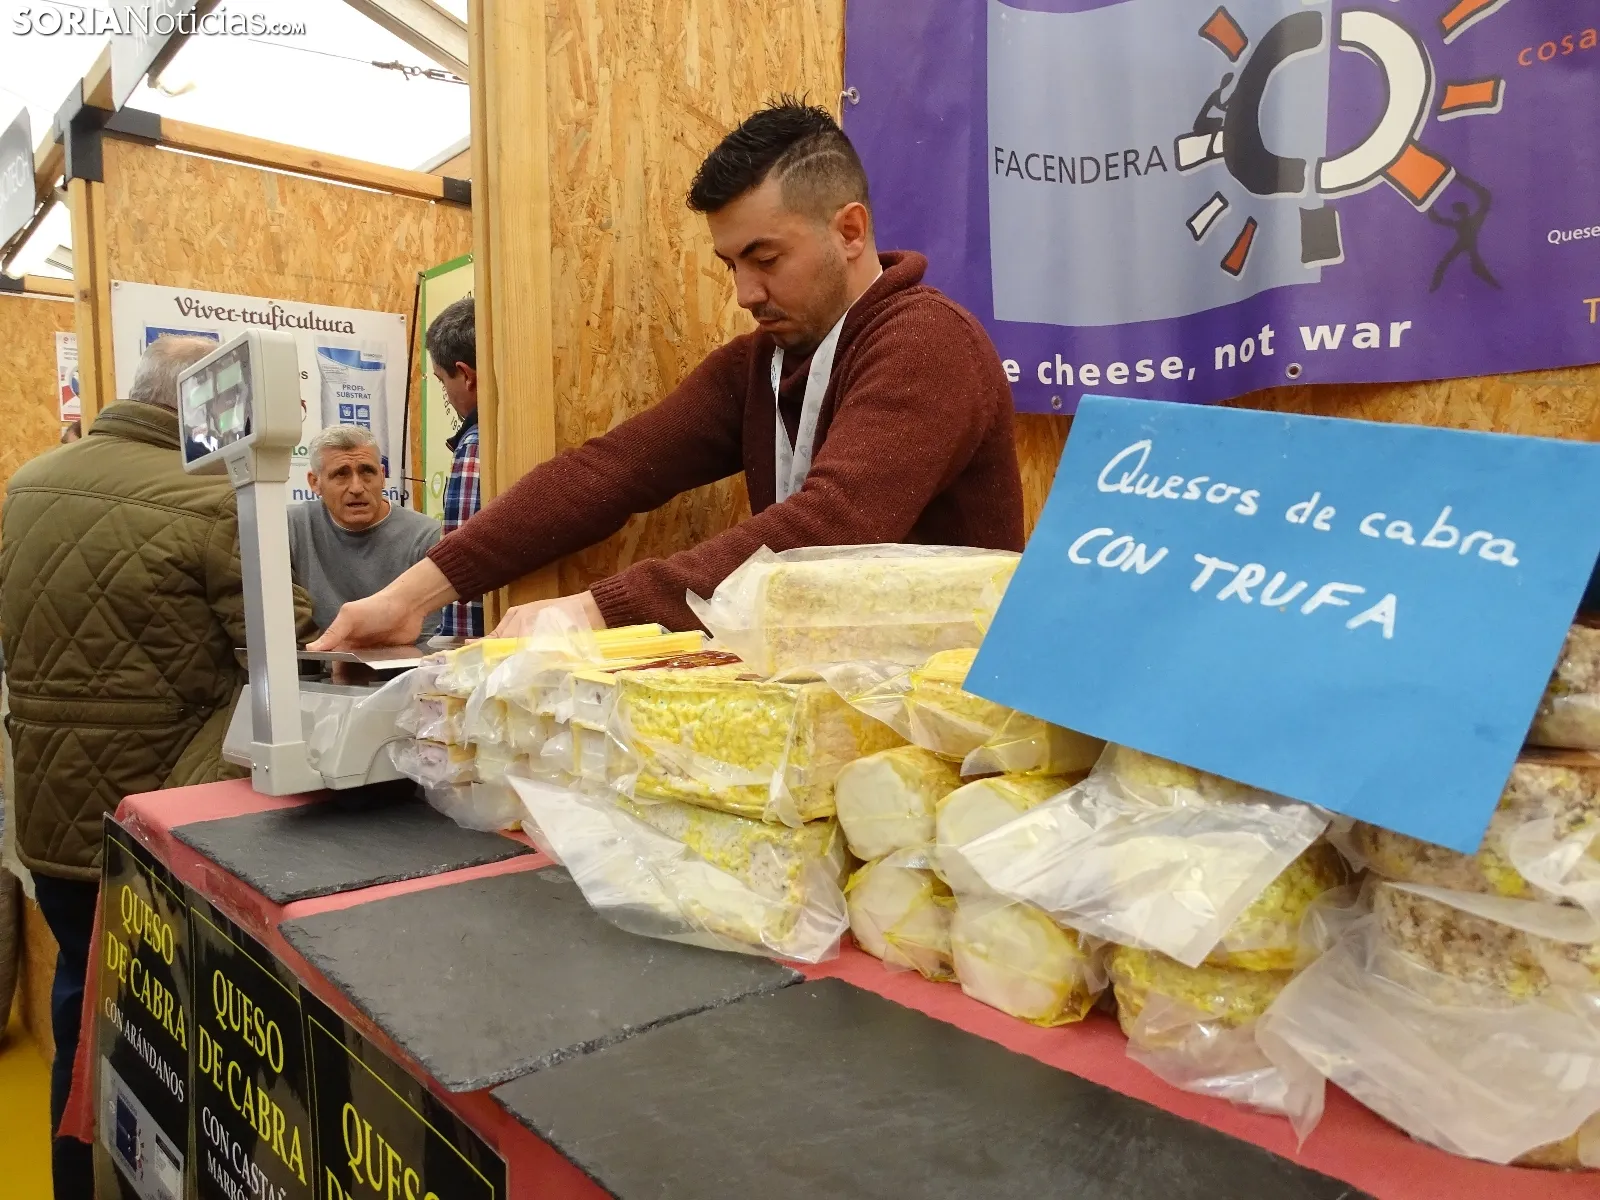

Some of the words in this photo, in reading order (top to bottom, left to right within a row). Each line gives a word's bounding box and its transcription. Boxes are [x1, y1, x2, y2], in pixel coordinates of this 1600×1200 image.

[994, 145, 1168, 185] FACENDERA
[174, 296, 356, 335] Viver-truficultura
[1037, 353, 1196, 386] cheese,
[1214, 326, 1275, 370] not
[1300, 320, 1412, 351] war
[336, 391, 372, 400] SUBSTRAT
[342, 383, 366, 392] PROFI-
[1097, 439, 1261, 516] Quesos
[1285, 492, 1336, 532] de
[1359, 505, 1520, 567] cabra
[1067, 527, 1169, 575] CON
[1189, 552, 1398, 640] TRUFA
[121, 885, 174, 966] QUESO
[107, 931, 127, 984] DE
[130, 957, 188, 1051] CABRA
[213, 969, 284, 1075] QUESO
[105, 997, 124, 1033] CON
[123, 1018, 185, 1104] ARÁNDANOS
[198, 1025, 223, 1092] DE
[228, 1060, 307, 1186] CABRA
[202, 1106, 230, 1160] CON
